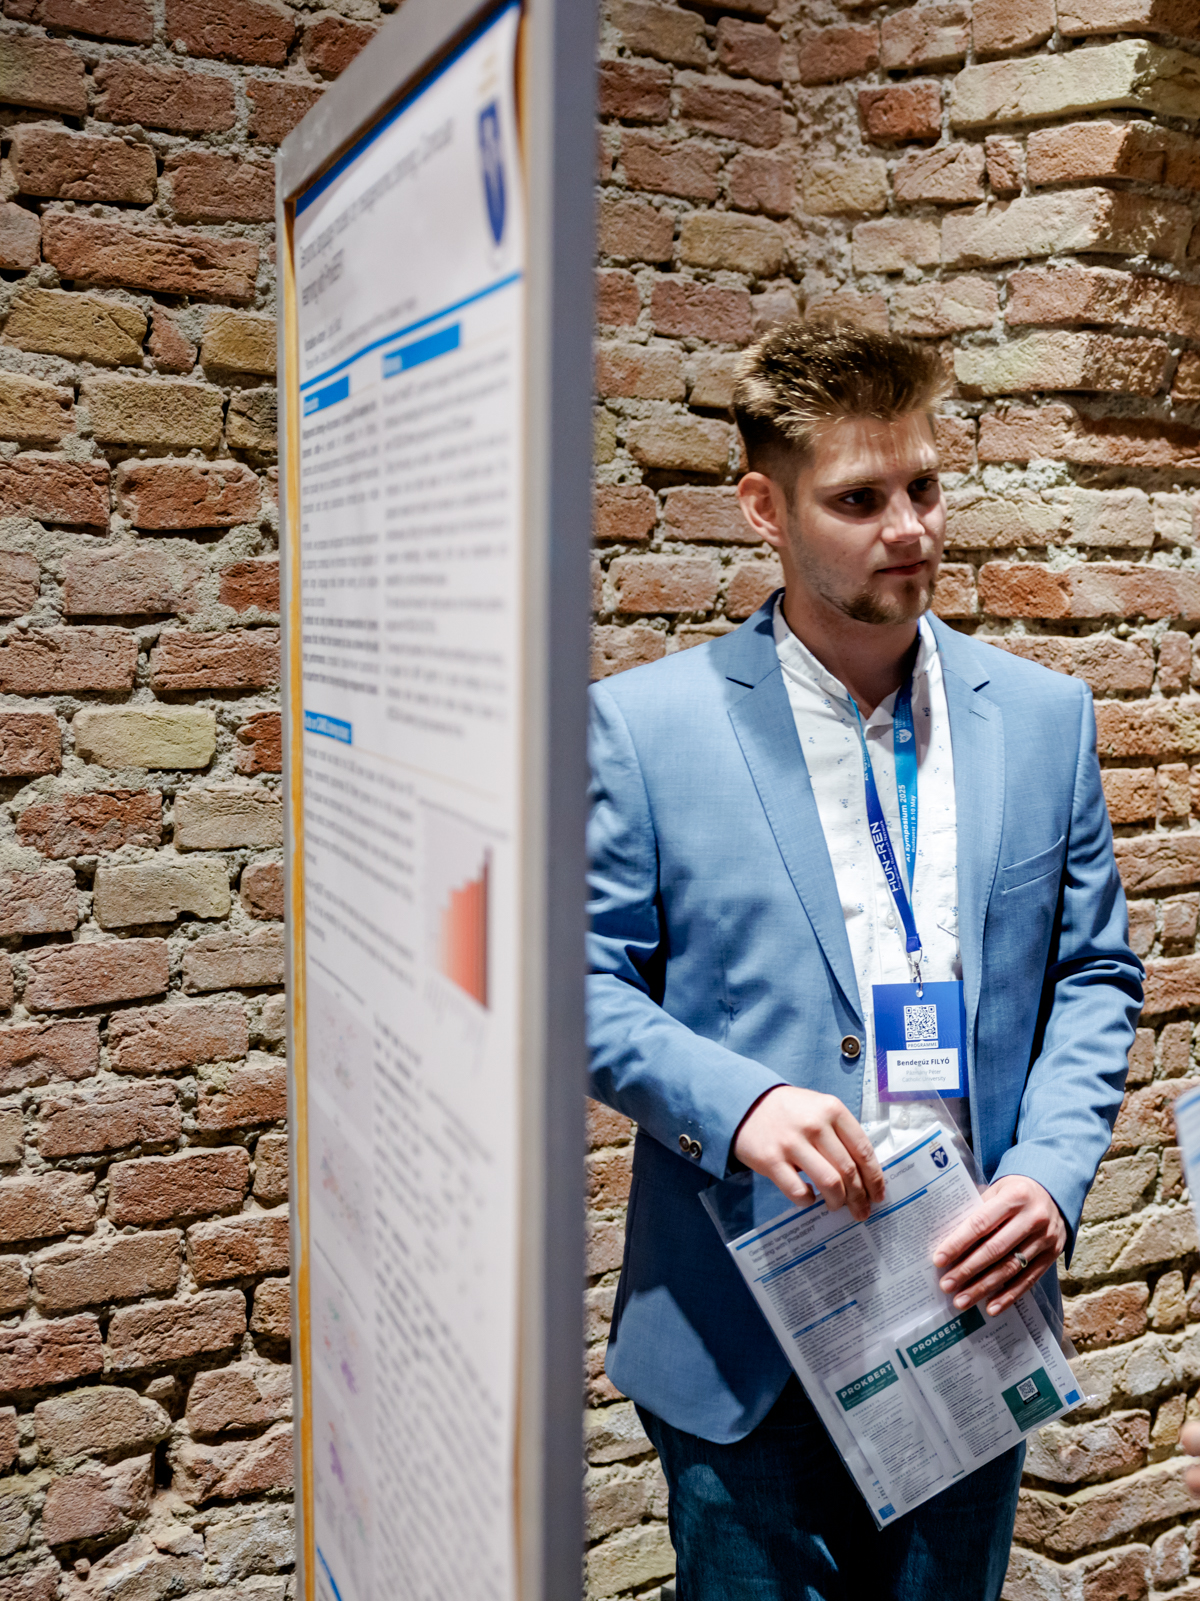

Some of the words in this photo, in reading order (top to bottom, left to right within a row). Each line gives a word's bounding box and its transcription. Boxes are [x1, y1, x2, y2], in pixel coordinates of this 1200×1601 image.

[898, 784, 906, 802] 2025
[900, 805, 910, 852] Symposium
[870, 821, 899, 893] HUN-REN
[906, 853, 910, 862] AI
[897, 1058, 930, 1067] Bendegúz
[931, 1057, 950, 1065] FILYÓ
[748, 1238, 774, 1257] Genomic
[773, 1224, 800, 1243] language
[799, 1213, 821, 1228] models
[820, 1208, 829, 1217] for
[889, 1162, 915, 1180] Curricular
[751, 1246, 775, 1263] learning
[774, 1239, 787, 1250] with
[787, 1224, 816, 1243] ProkBERT
[911, 1318, 962, 1354] PROKBERT
[840, 1363, 892, 1398] PROKBERT
